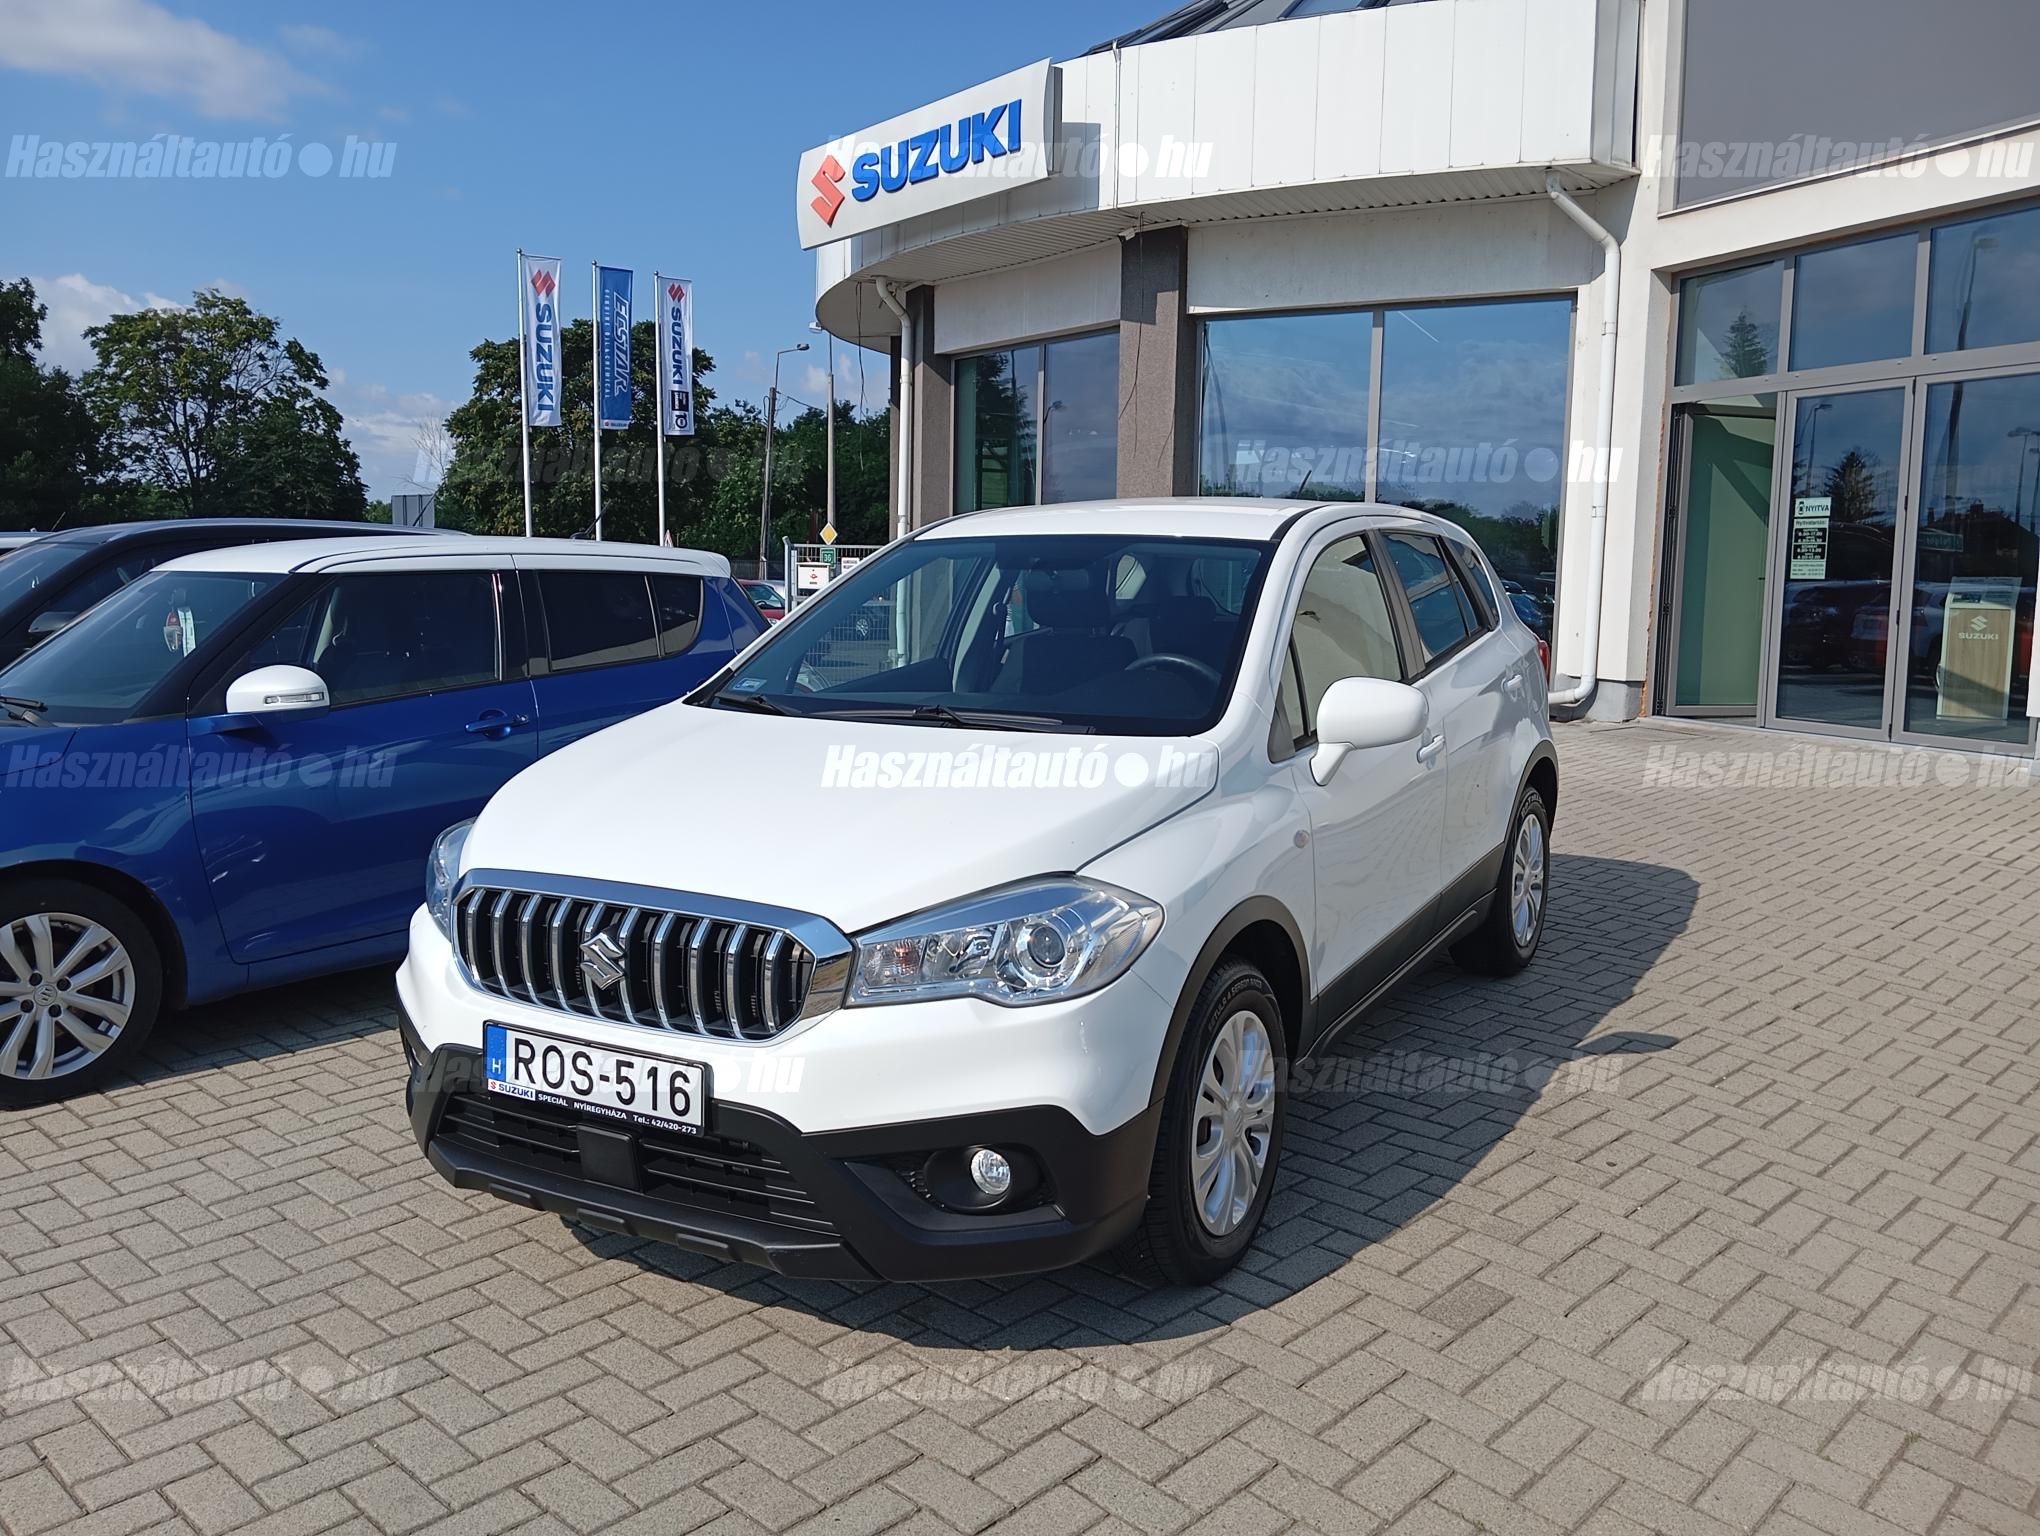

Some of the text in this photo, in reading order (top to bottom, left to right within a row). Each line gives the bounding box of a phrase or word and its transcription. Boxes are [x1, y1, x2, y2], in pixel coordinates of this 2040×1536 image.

[851, 98, 1022, 201] SUZUKI
[535, 302, 553, 412] SUZUKI
[671, 306, 683, 385] SUZUKI
[1805, 504, 1829, 512] NYITVA
[1958, 632, 1999, 640] SUZUKI
[492, 1058, 501, 1075] H
[514, 1037, 691, 1117] ROS-516
[498, 1083, 534, 1099] SUZUKI
[538, 1093, 569, 1107] SPECIÁL
[573, 1101, 627, 1120] NYÍREGYHÁZA
[651, 1118, 697, 1135] 42/420-273
